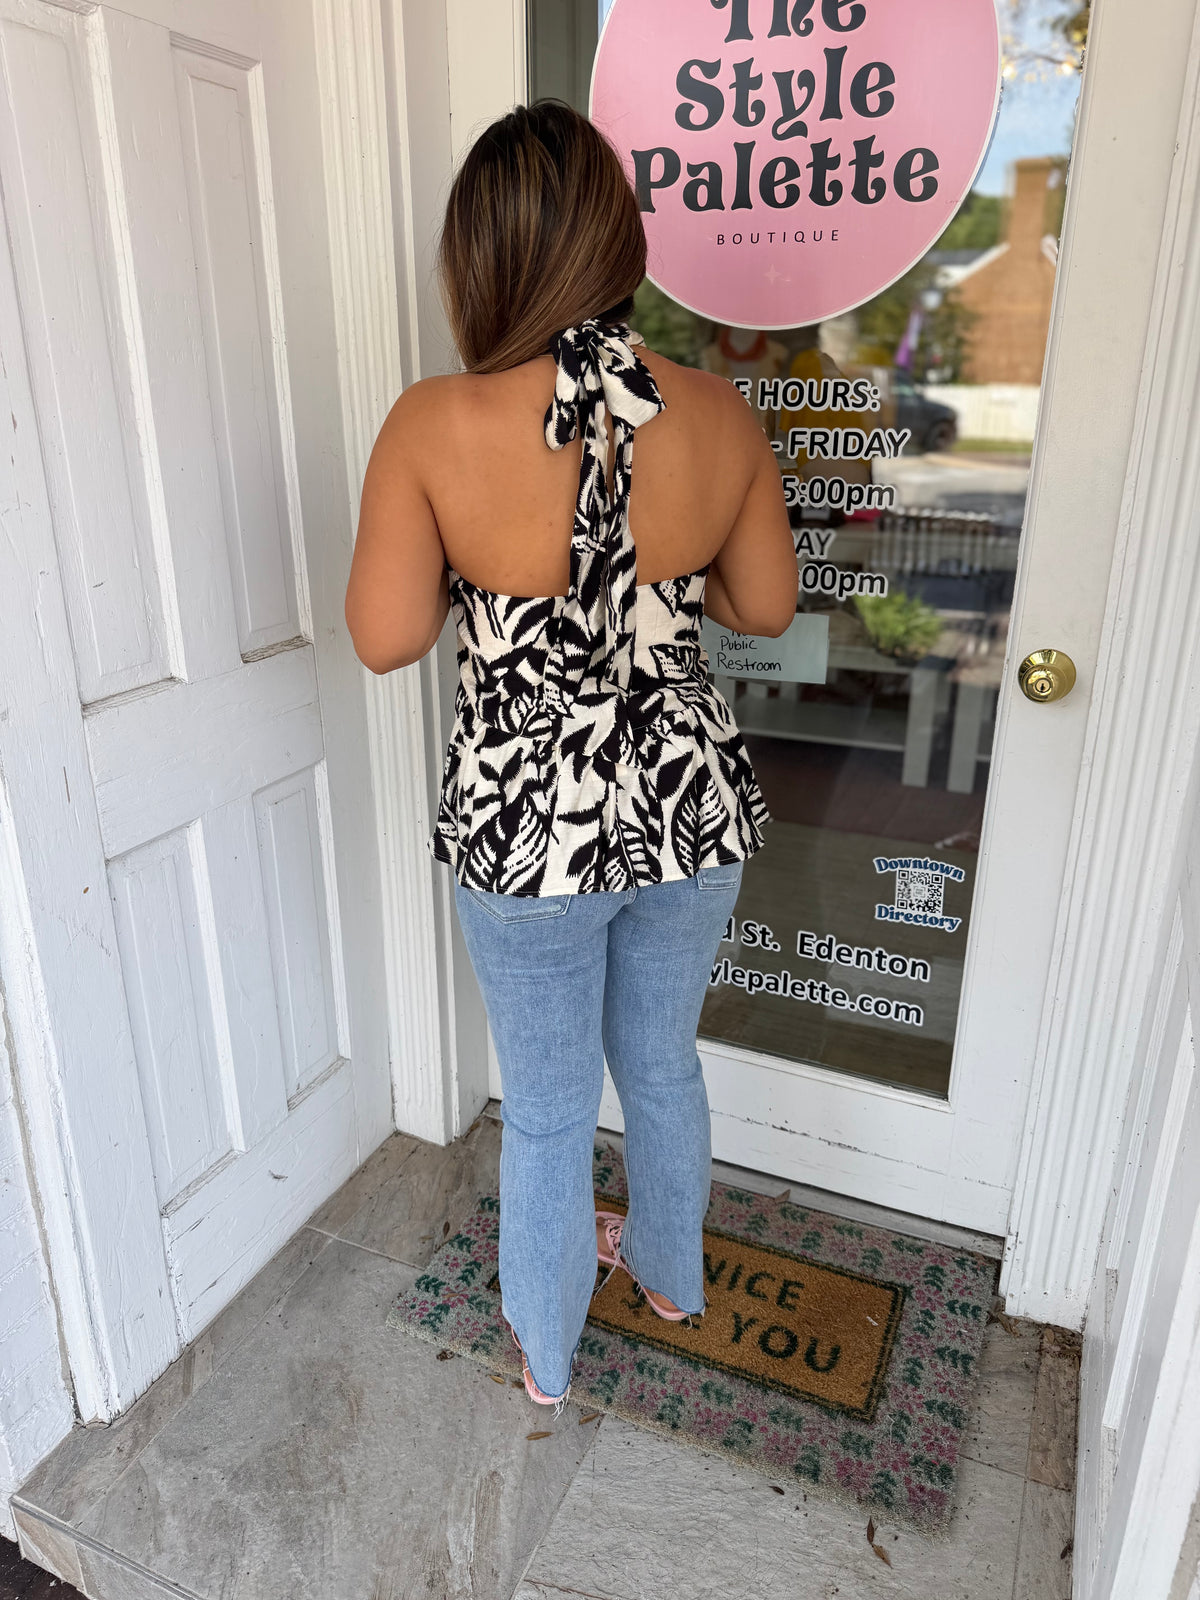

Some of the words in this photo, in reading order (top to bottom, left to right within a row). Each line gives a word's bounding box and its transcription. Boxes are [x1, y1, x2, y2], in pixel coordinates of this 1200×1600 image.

[711, 0, 867, 43] The
[674, 45, 896, 141] Style
[631, 134, 940, 213] Palette
[716, 229, 841, 246] BOUTIQUE
[759, 378, 880, 410] HOURS:
[788, 430, 910, 459] FRIDAY
[720, 636, 758, 651] Public
[716, 652, 782, 672] Restroom
[874, 857, 965, 881] Downtown
[876, 904, 961, 931] Directory
[742, 921, 780, 951] St.
[798, 931, 930, 981] Edenton
[730, 1311, 842, 1373] YOU
